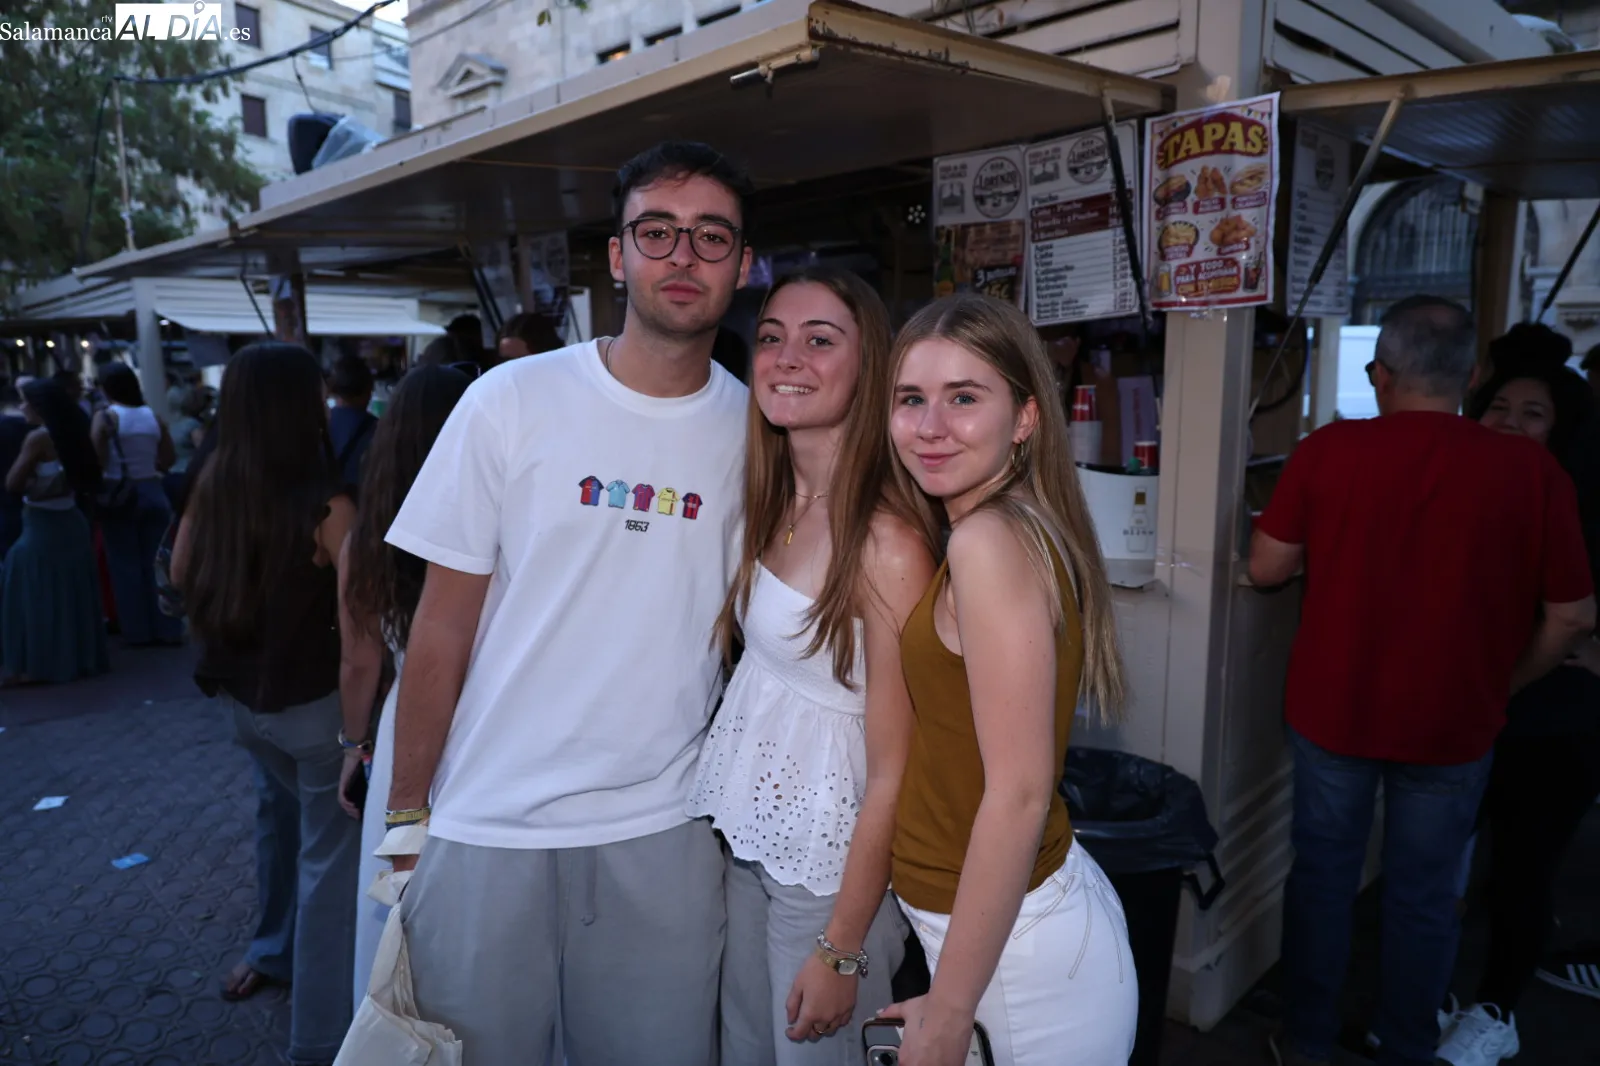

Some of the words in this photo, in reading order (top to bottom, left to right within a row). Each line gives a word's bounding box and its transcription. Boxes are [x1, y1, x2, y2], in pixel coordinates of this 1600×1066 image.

[1163, 121, 1263, 165] TAPAS
[1188, 263, 1197, 273] Y
[1199, 259, 1224, 272] TODO
[625, 519, 650, 532] 1863
